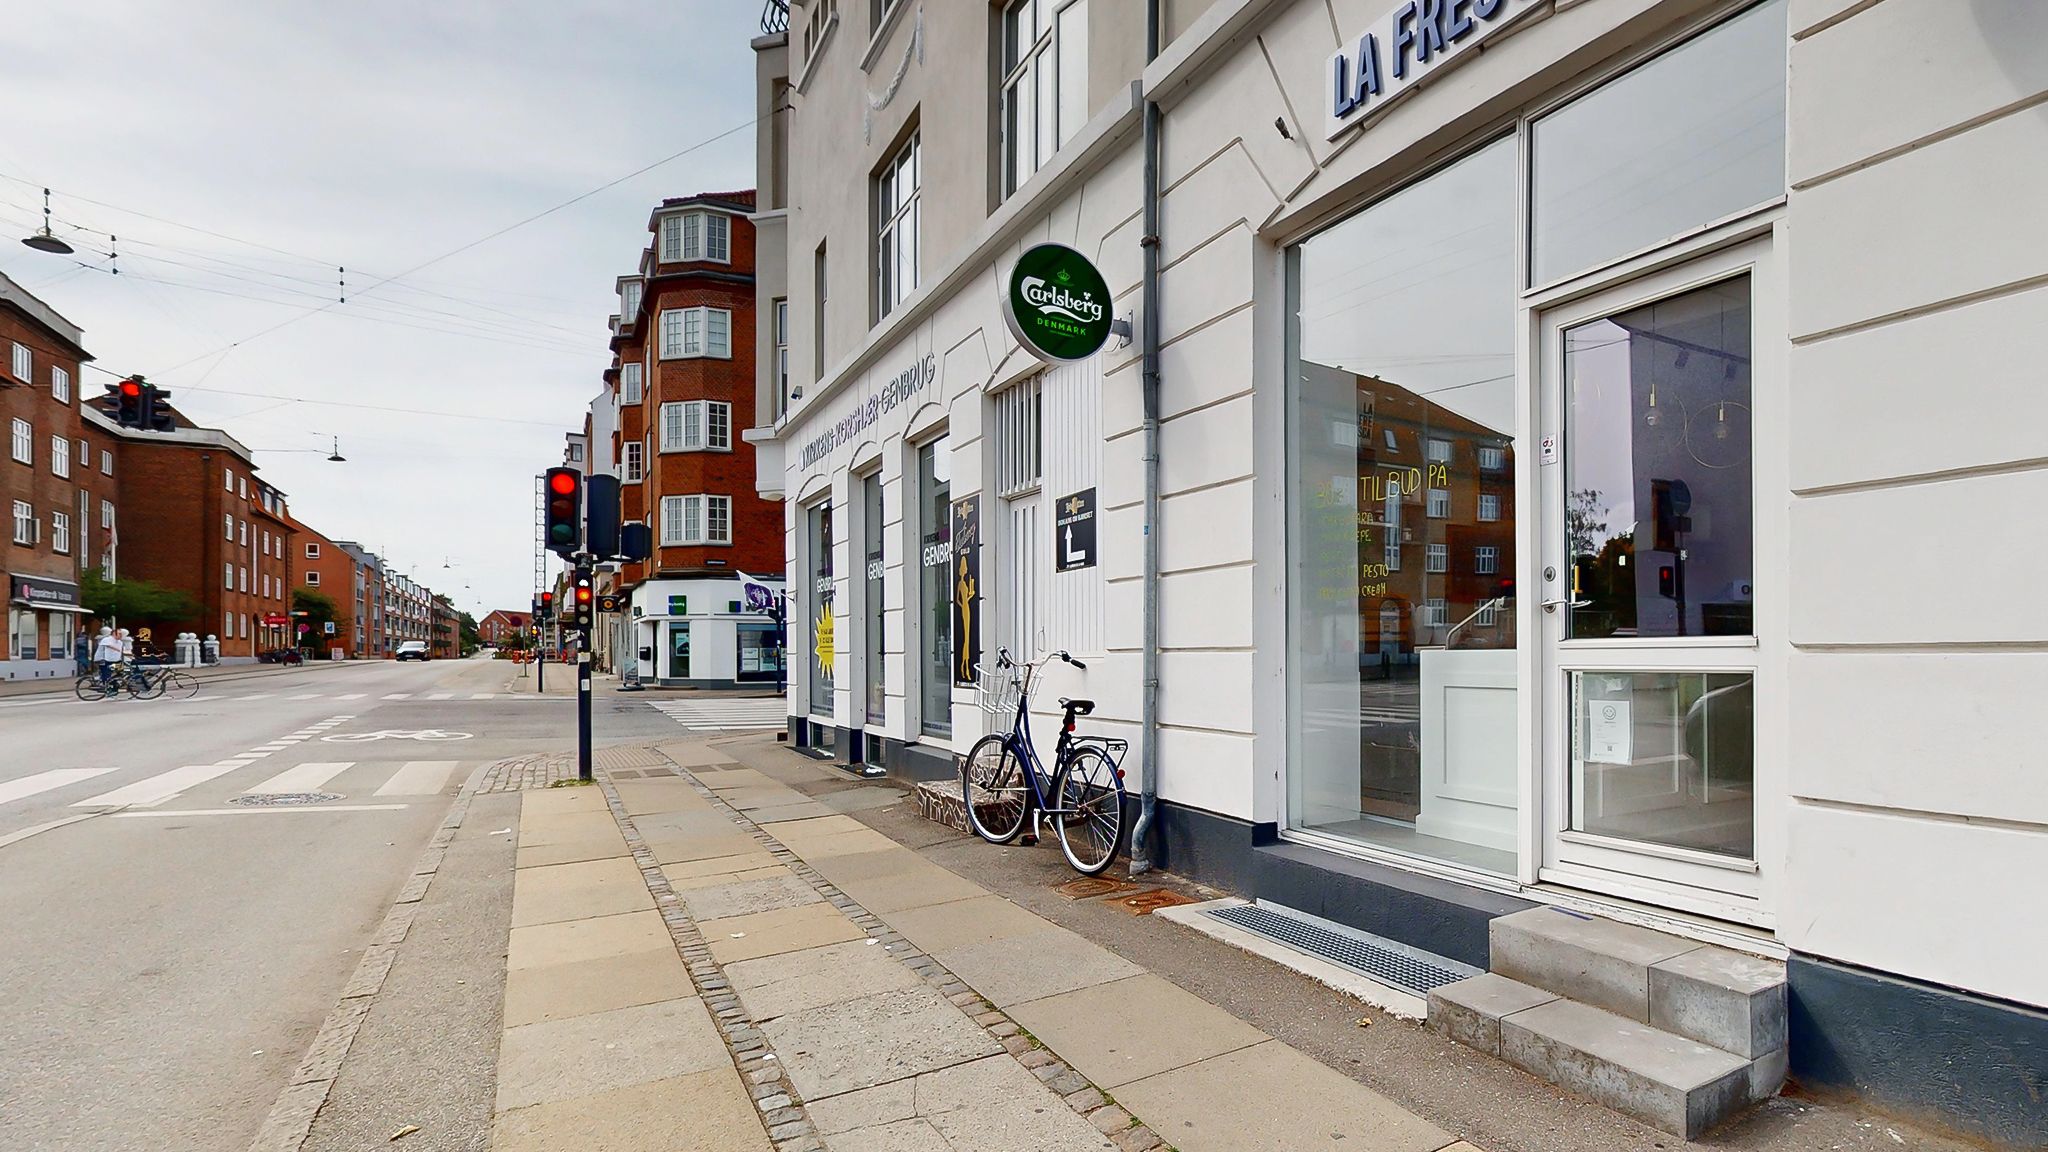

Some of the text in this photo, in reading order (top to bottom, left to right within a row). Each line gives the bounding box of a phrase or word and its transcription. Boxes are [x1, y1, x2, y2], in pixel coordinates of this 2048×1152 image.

[1334, 32, 1379, 118] LA
[1020, 275, 1103, 322] Carlsberg
[1037, 317, 1087, 336] DENMARK
[1360, 467, 1421, 502] TILBUD
[923, 541, 952, 567] GENBR
[1363, 563, 1389, 578] PESTO
